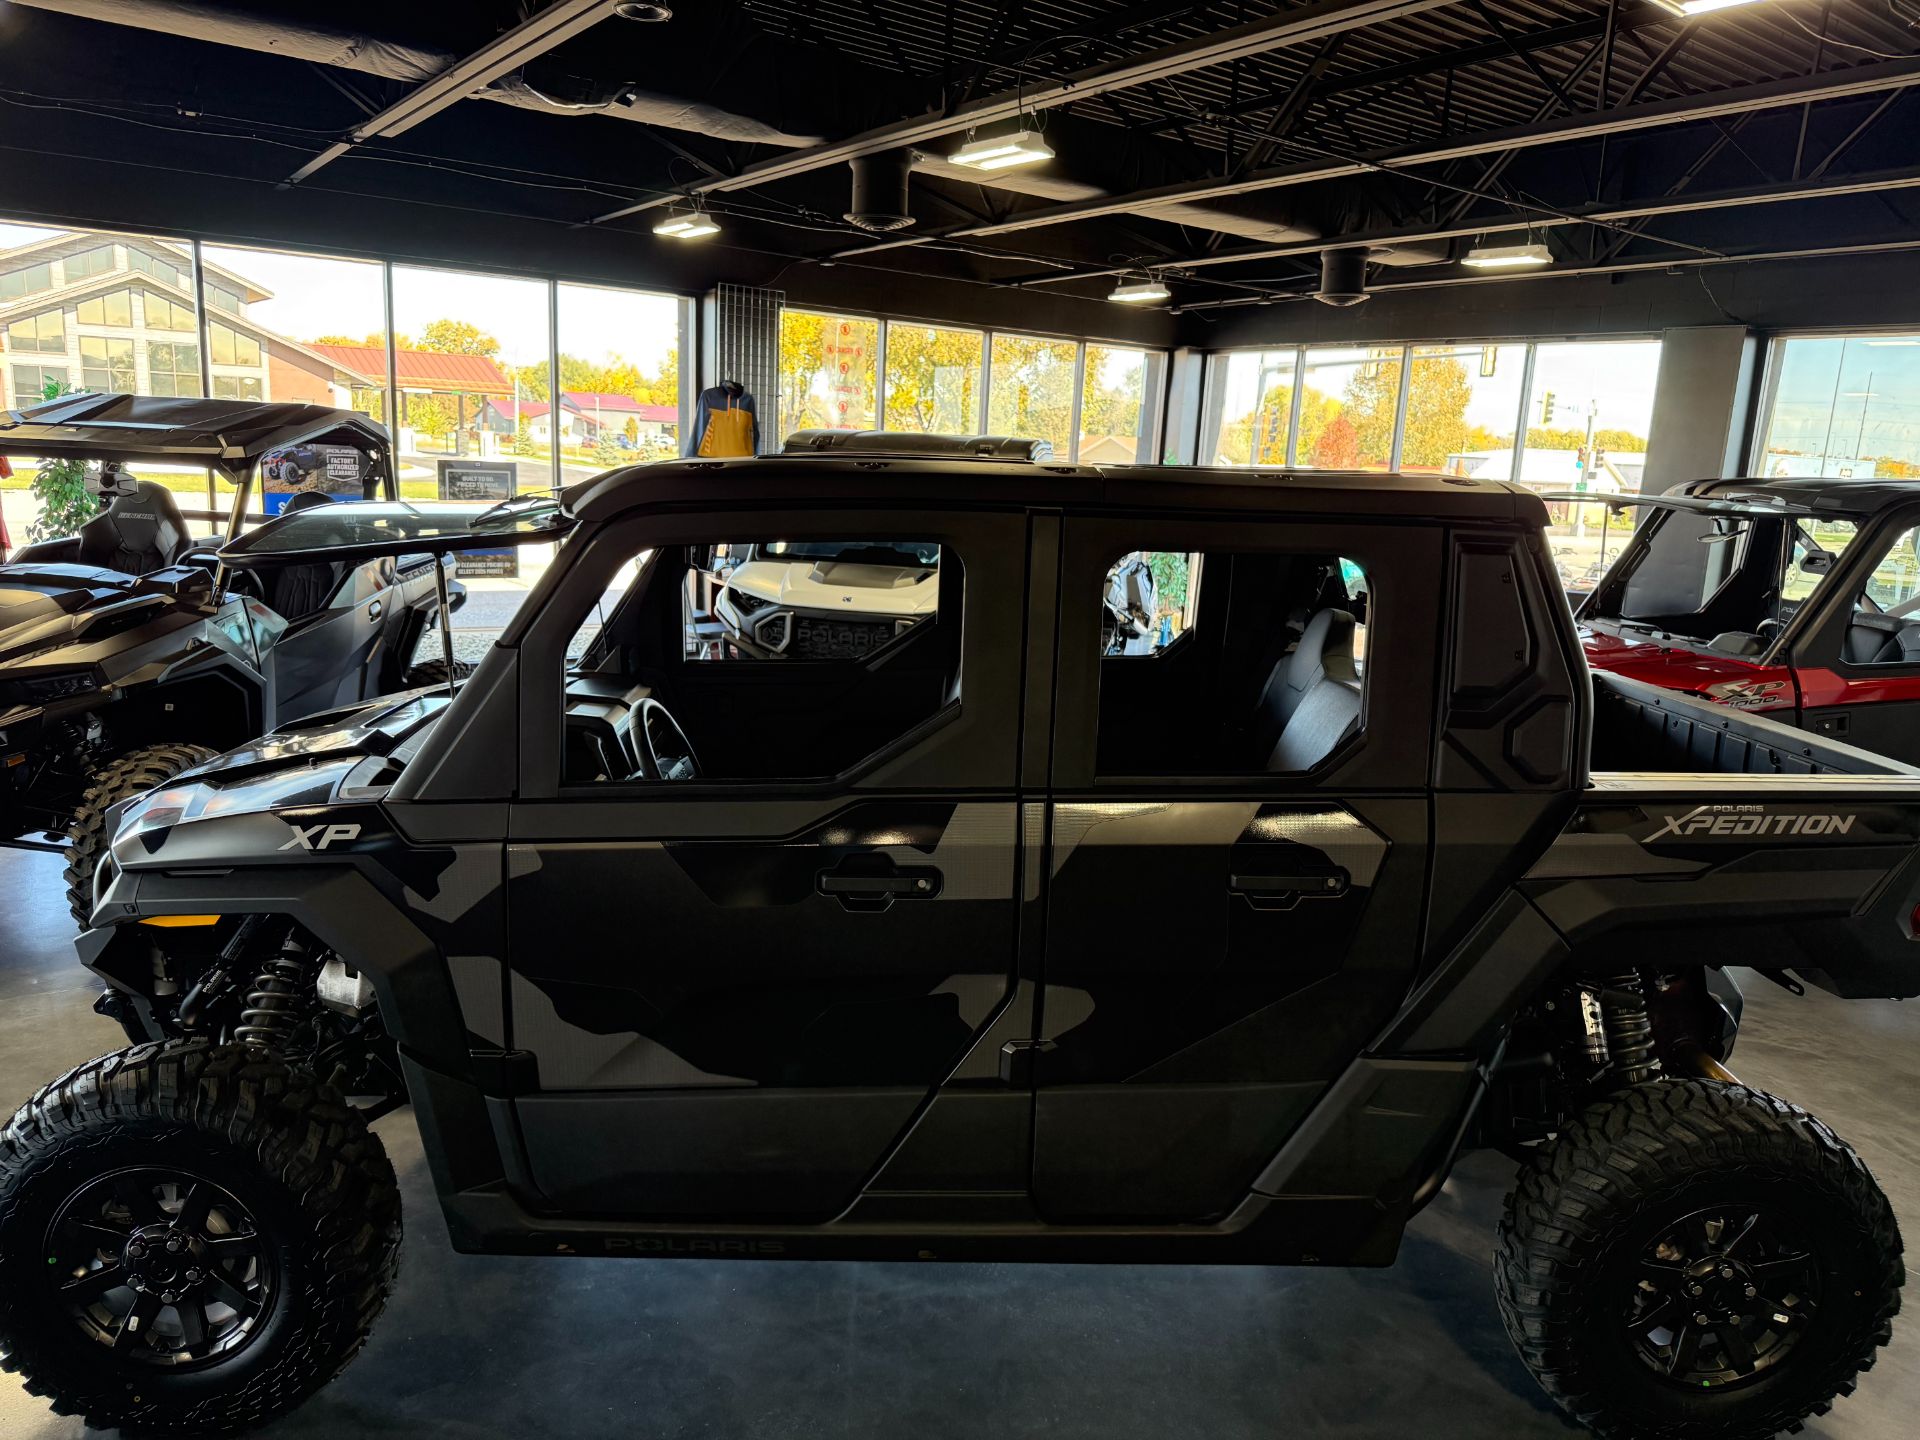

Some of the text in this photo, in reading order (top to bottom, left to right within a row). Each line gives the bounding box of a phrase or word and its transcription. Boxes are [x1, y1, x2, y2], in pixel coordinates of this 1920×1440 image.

[797, 629, 890, 647] POLARIS
[1722, 681, 1786, 701] XP
[1713, 805, 1764, 813] POLARIS
[1641, 806, 1856, 843] XPEDITION
[276, 824, 361, 851] XP
[604, 1238, 785, 1253] POLARIS
